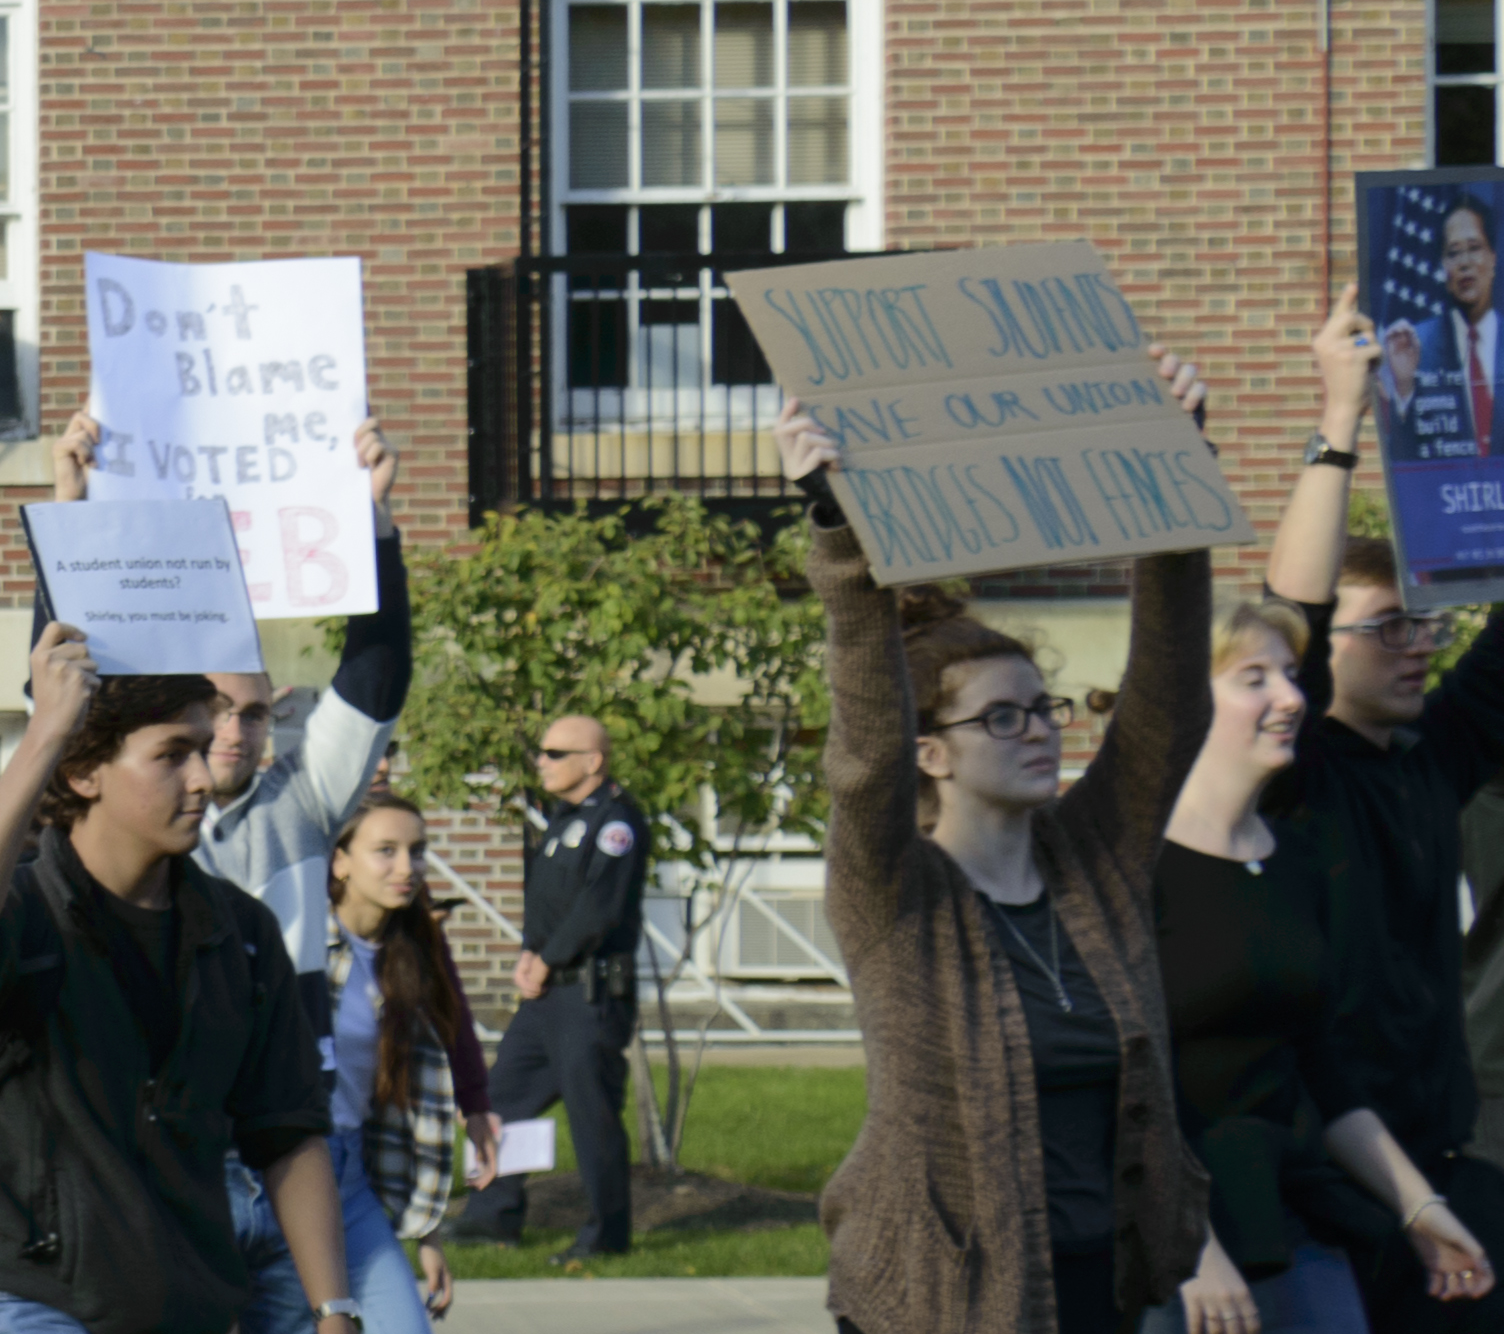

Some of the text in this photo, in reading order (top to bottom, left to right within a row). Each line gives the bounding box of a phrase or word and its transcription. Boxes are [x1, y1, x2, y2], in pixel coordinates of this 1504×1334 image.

[96, 277, 259, 340] Don't
[764, 273, 1144, 386] SUPPORT STUDENTS
[175, 349, 339, 397] Blame
[808, 378, 1164, 448] SAVE OUR UNION
[1417, 413, 1458, 435] build
[106, 432, 297, 486] I VOTED
[843, 448, 1234, 567] BRIDGES NOT FENCES
[56, 557, 231, 573] A student union not run by
[119, 576, 181, 590] students?
[129, 613, 148, 623] you
[150, 611, 176, 622] must
[178, 610, 192, 621] be
